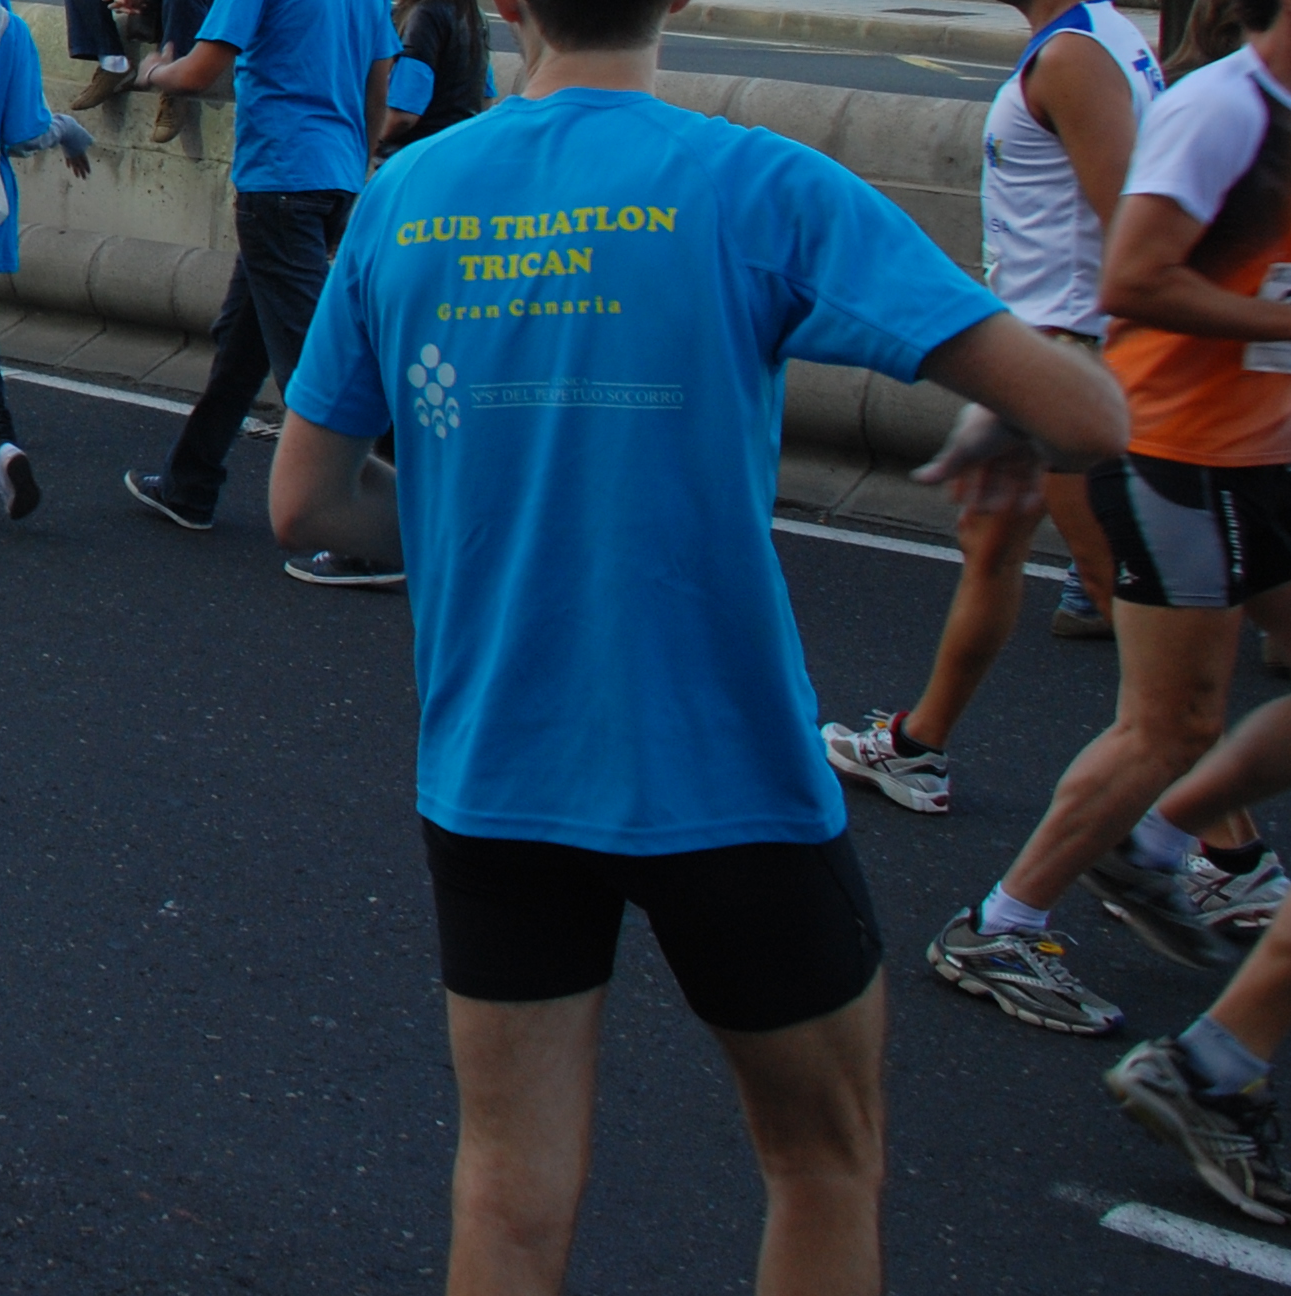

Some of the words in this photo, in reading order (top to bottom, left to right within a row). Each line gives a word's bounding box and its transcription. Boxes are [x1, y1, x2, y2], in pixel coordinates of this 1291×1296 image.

[396, 215, 482, 247] CLUB
[490, 205, 679, 243] TRIATLON
[457, 247, 594, 282] TRICAN
[436, 302, 501, 322] Gran
[508, 296, 623, 319] Canaria
[501, 389, 533, 402] DEL
[605, 389, 685, 404] SOCORRO
